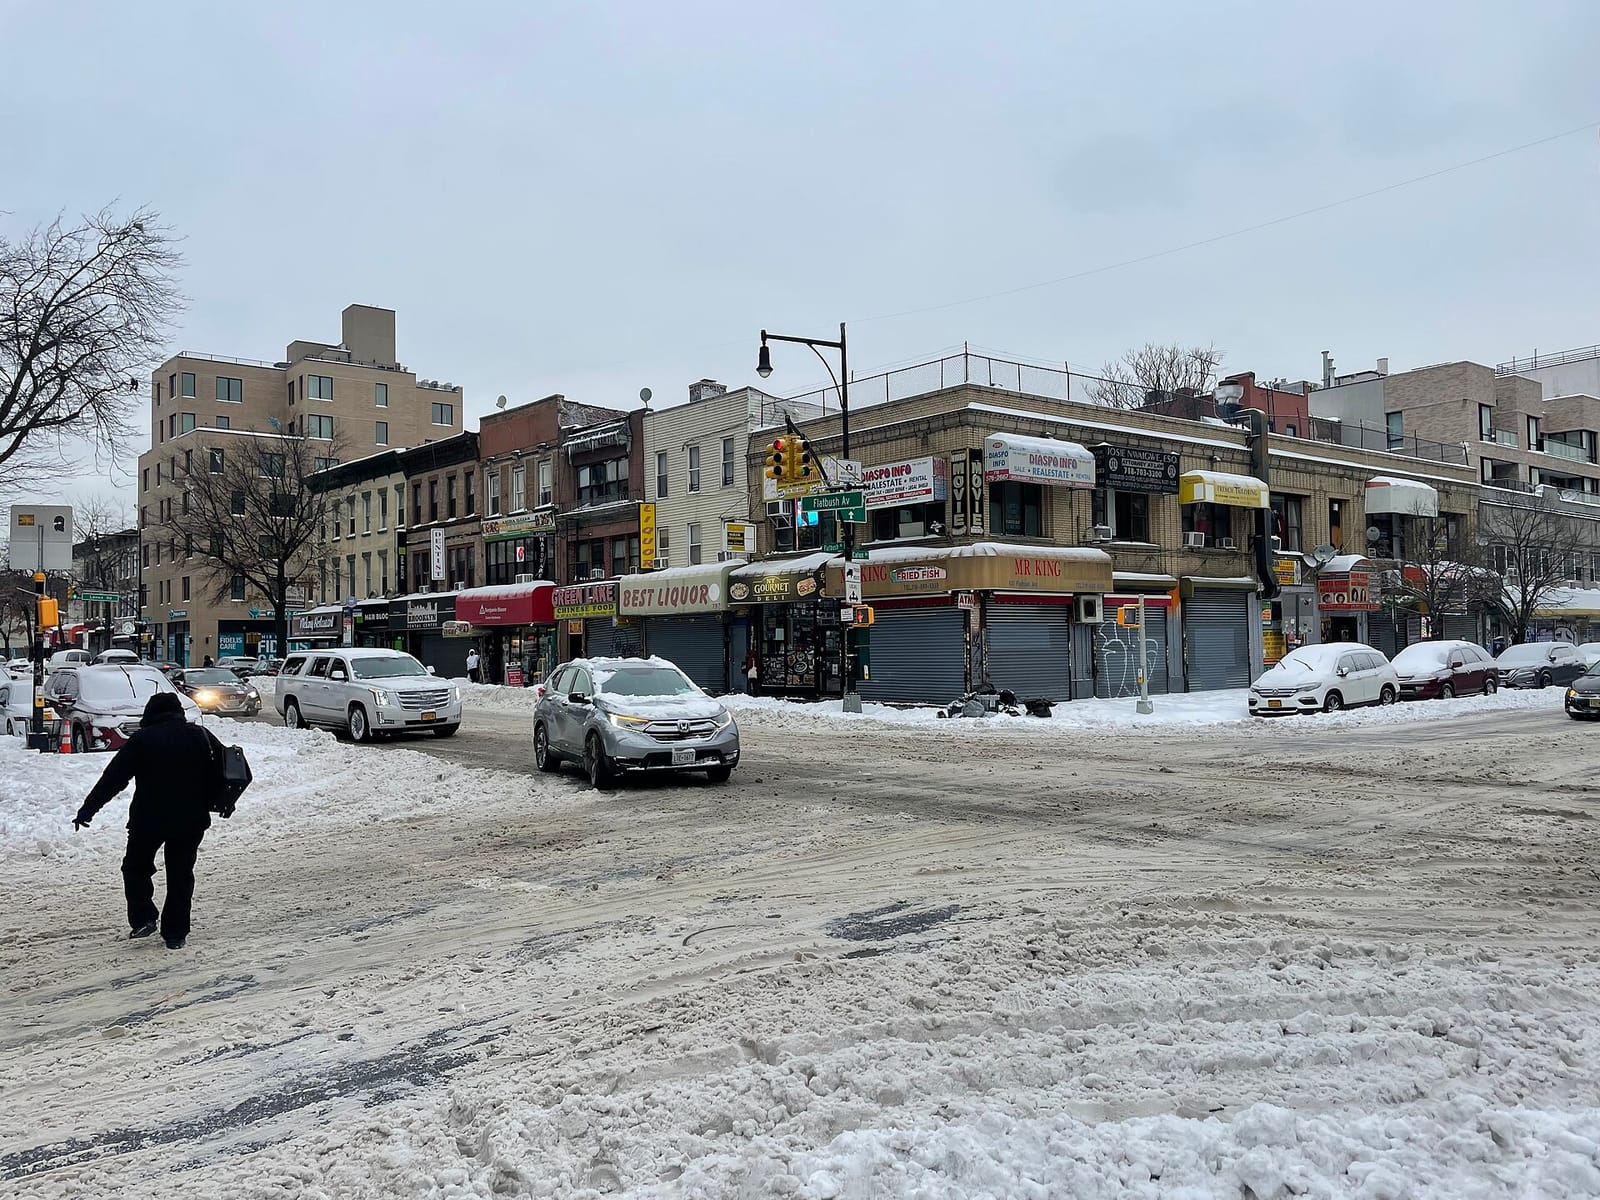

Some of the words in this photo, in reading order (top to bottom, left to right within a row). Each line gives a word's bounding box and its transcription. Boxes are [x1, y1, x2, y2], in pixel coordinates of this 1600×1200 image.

[989, 451, 1009, 459] DIASPO
[1107, 447, 1126, 457] JOSIE
[1029, 453, 1058, 468] DIASPO
[1059, 457, 1078, 470] INFO
[891, 463, 912, 478] INFO
[1032, 467, 1070, 479] REALESTATE
[813, 497, 840, 508] Flatbush
[841, 495, 850, 505] Av
[953, 462, 965, 527] MOVIE
[971, 462, 982, 526] MOVIE
[642, 505, 654, 568] LIQUOR
[435, 531, 443, 577] DENTIST
[860, 565, 887, 583] KING
[897, 571, 919, 580] FRIED
[922, 570, 940, 579] FISH
[1014, 558, 1031, 575] MR
[1035, 559, 1061, 577] KING
[552, 587, 583, 607] GREEN
[586, 584, 615, 604] LAKE
[623, 588, 654, 608] BEST
[657, 584, 709, 608] LIQUOR
[754, 582, 789, 594] GOURMET
[408, 613, 437, 623] BROOKLYN
[557, 606, 590, 614] CHINESE
